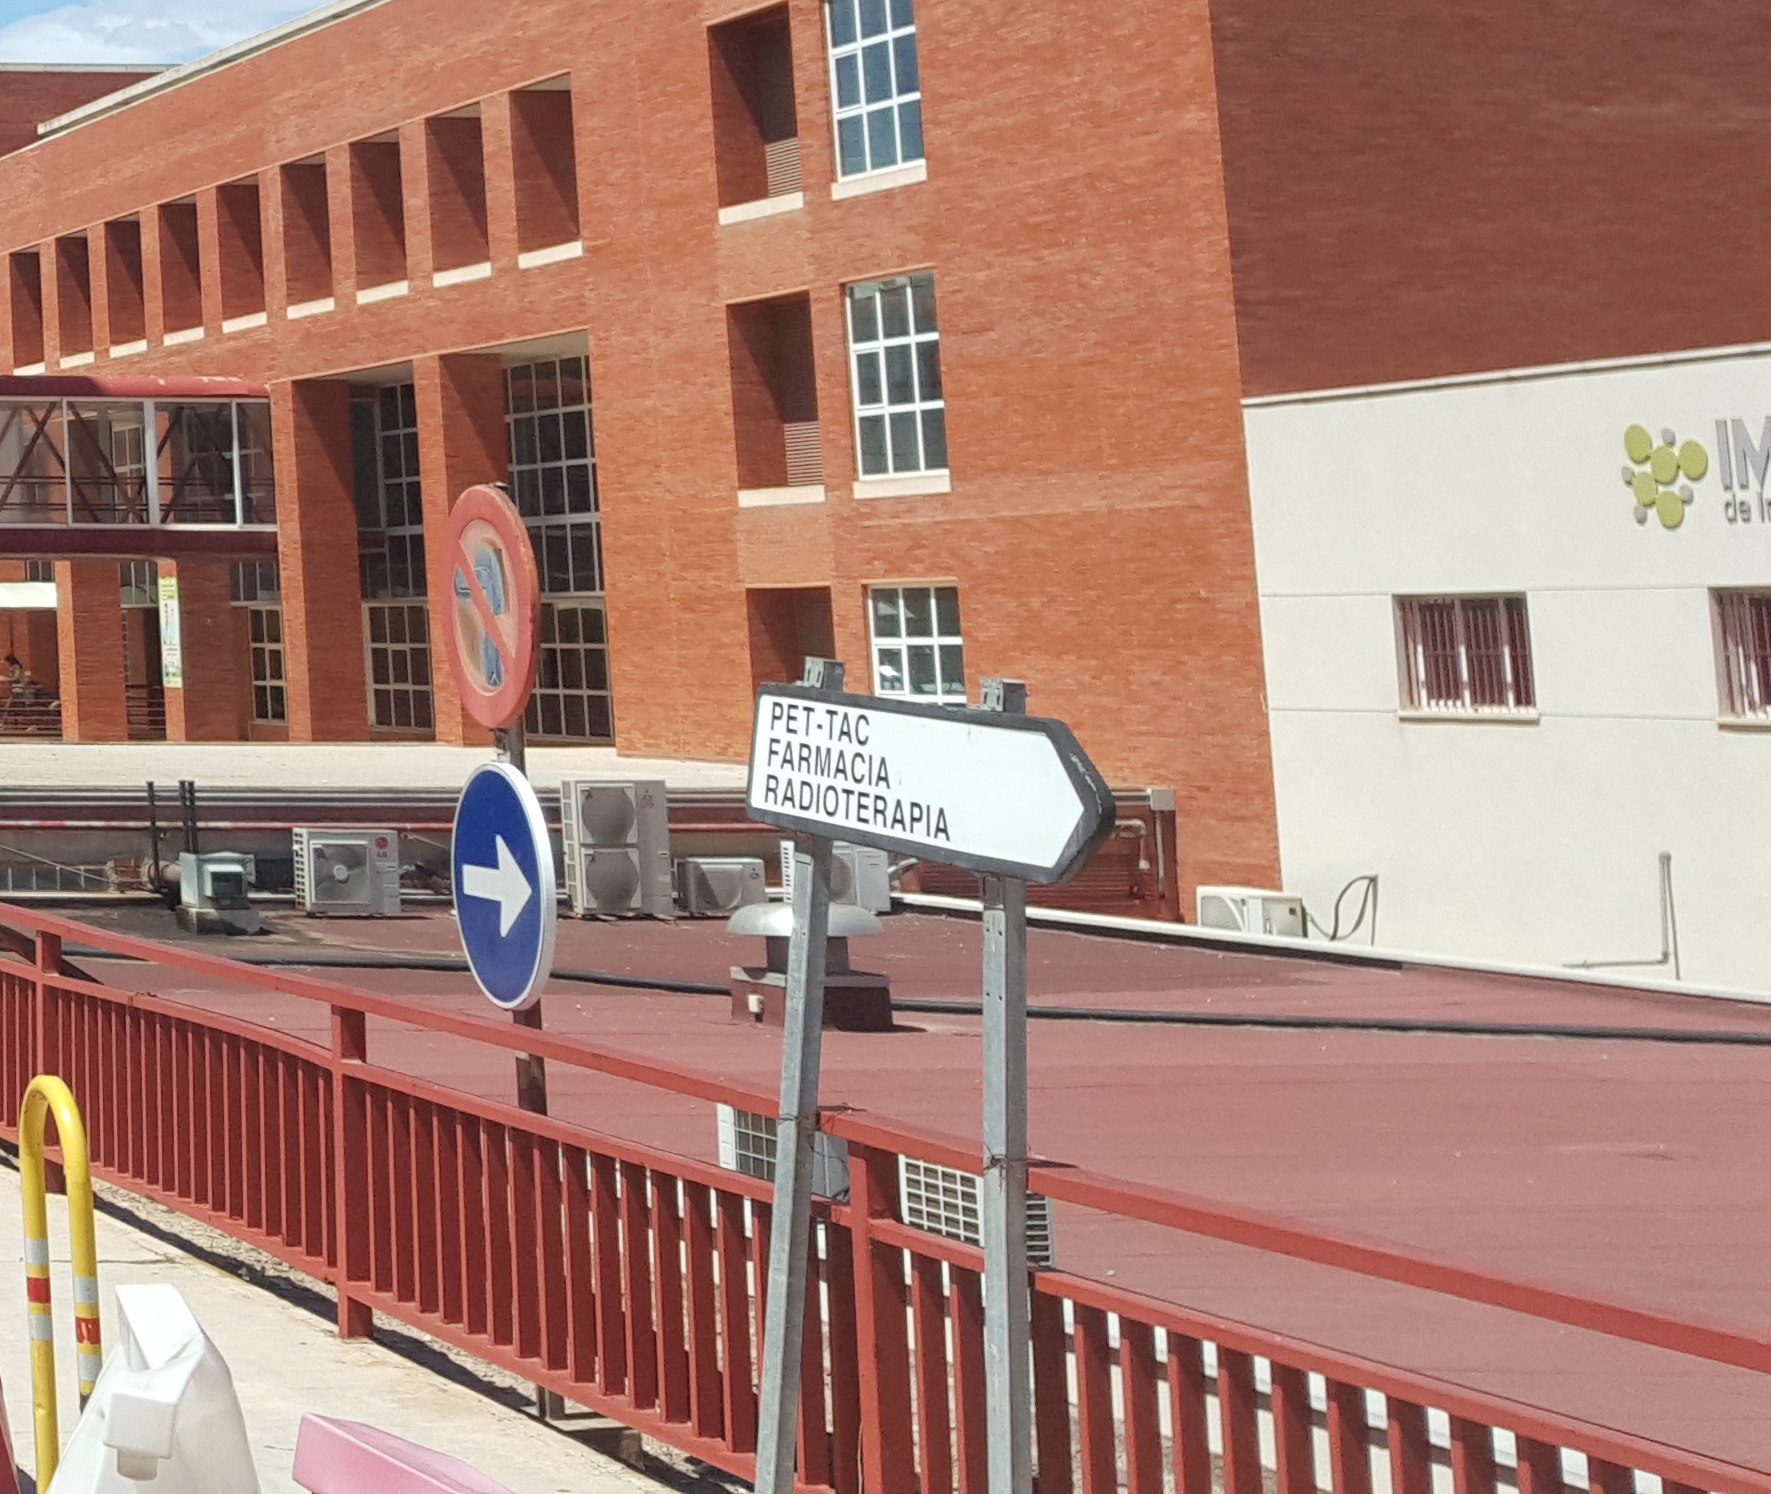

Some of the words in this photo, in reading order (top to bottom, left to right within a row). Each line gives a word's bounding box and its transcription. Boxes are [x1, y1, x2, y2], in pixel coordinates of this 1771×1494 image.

[1724, 491, 1752, 525] de
[770, 701, 871, 747] PET-TAC
[766, 738, 891, 790] FARMACIA
[764, 773, 951, 842] RADIOTERAPIA
